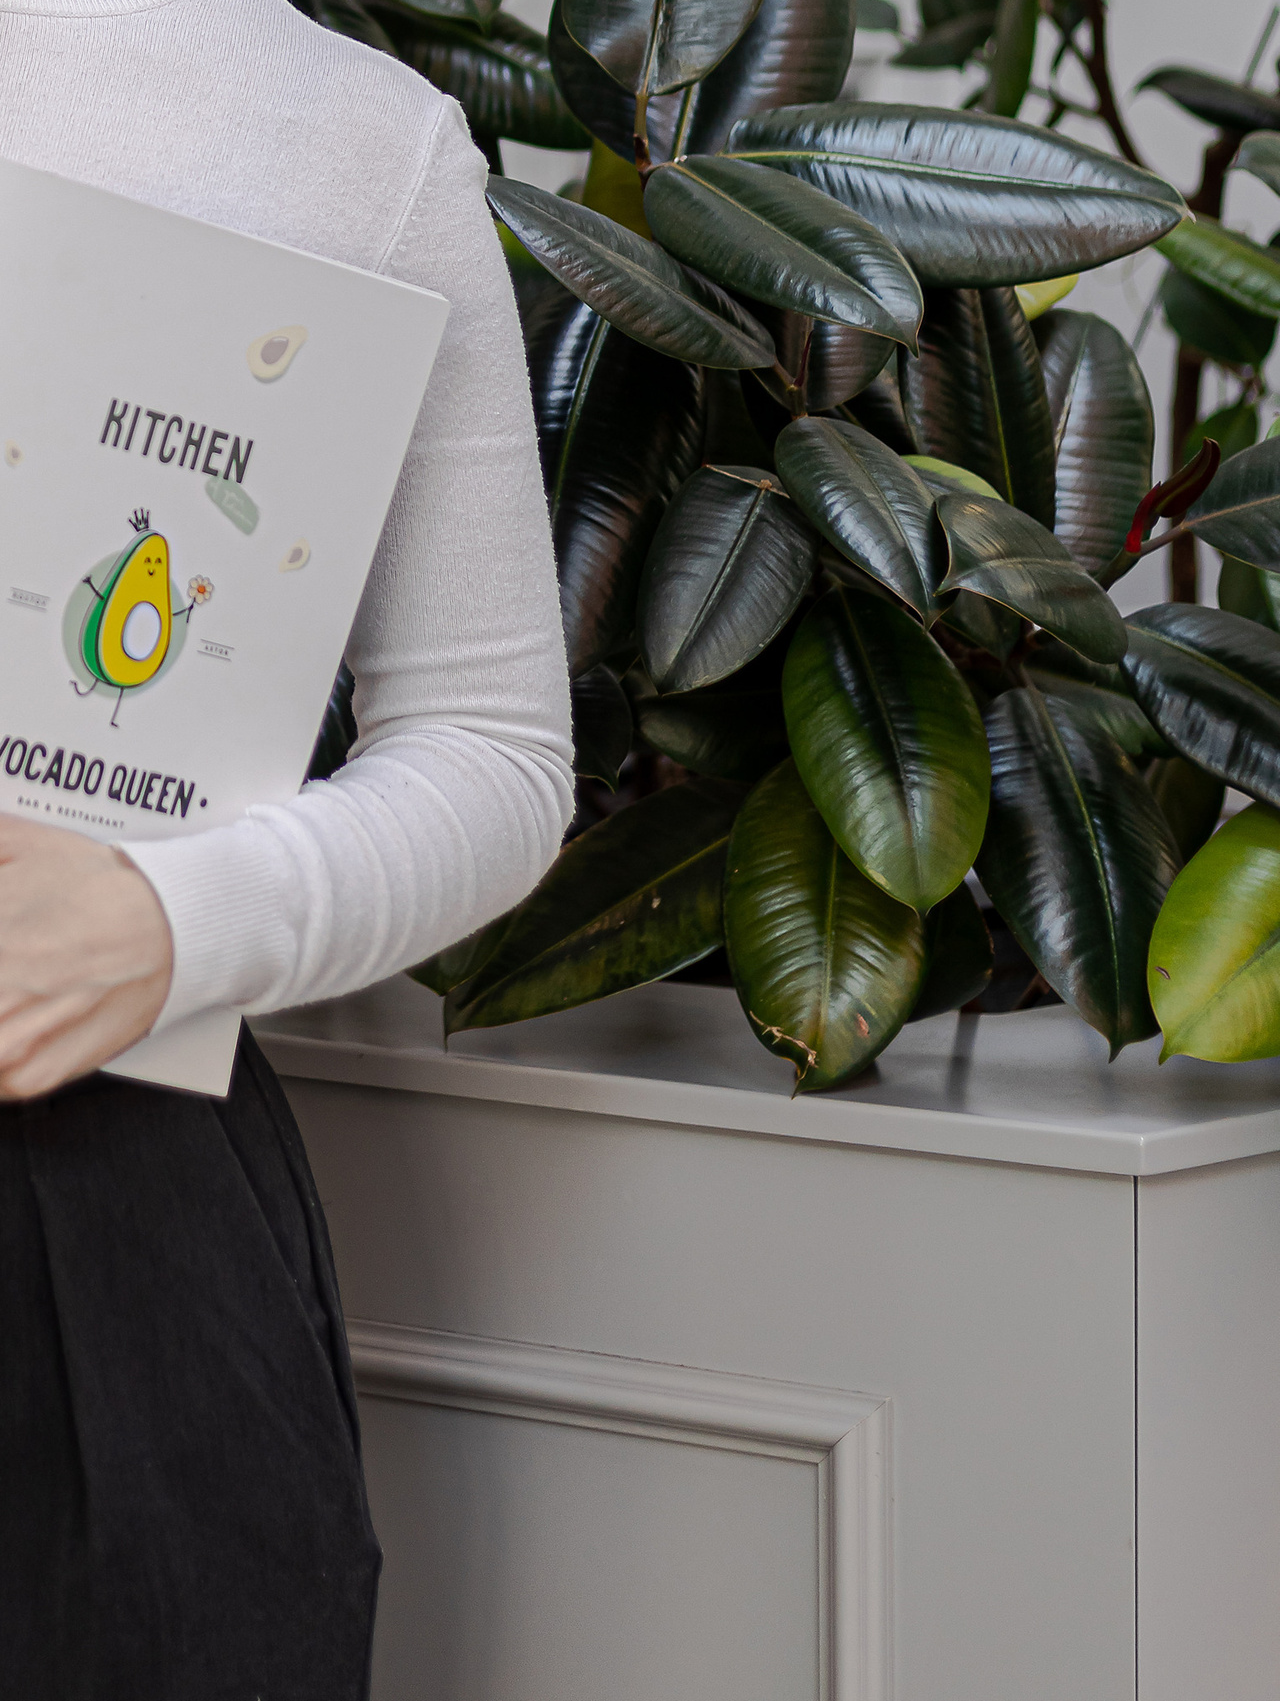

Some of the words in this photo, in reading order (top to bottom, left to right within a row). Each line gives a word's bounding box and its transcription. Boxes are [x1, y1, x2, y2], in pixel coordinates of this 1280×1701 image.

[100, 399, 254, 484] KITCHEN
[57, 804, 125, 830] RESTAURANT
[107, 764, 196, 818] QUEEN
